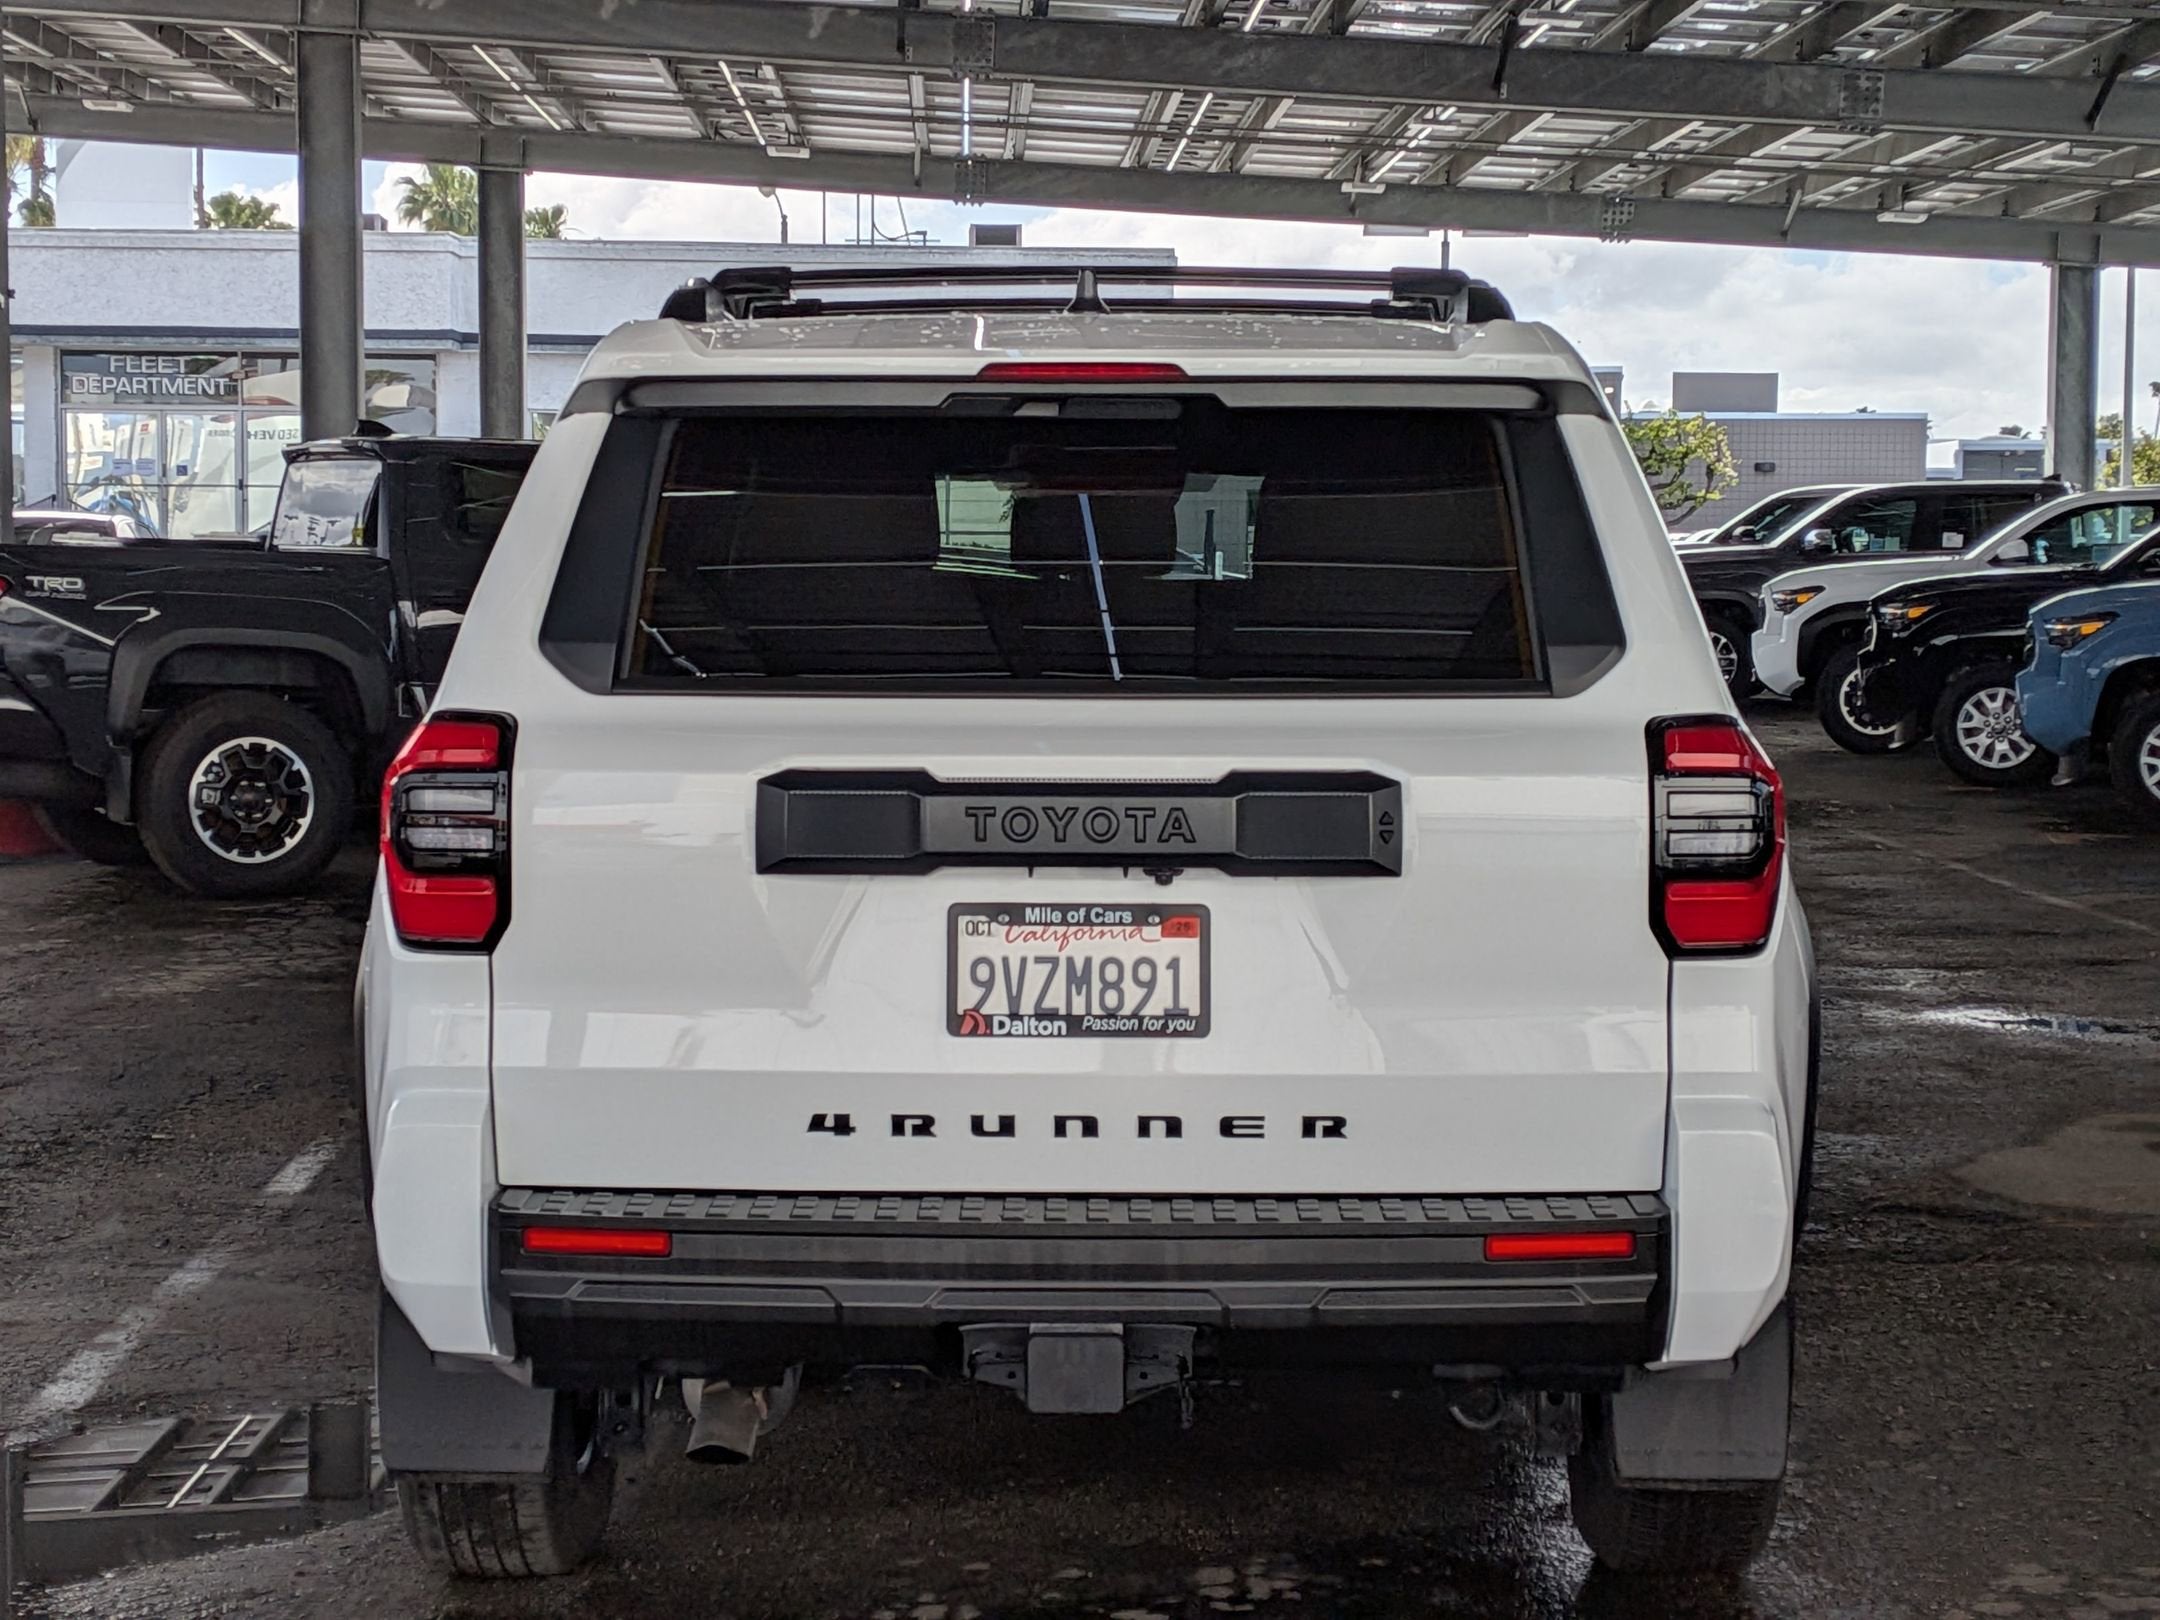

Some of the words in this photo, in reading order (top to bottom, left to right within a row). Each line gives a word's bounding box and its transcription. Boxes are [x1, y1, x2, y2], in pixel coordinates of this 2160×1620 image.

[109, 355, 187, 374] FLEET
[71, 376, 230, 396] DEPARTMENT
[25, 575, 83, 592] TRD
[965, 805, 1197, 845] TOYOTA
[1025, 906, 1062, 923] Mile
[1066, 906, 1087, 923] of
[1090, 906, 1133, 923] Cars
[965, 919, 992, 937] OCT
[1005, 924, 1161, 953] California
[969, 956, 1190, 1016] 9VZM891
[992, 1015, 1067, 1036] Dalton
[1082, 1015, 1138, 1031] Passion
[1142, 1016, 1165, 1031] for
[1165, 1018, 1196, 1034] you
